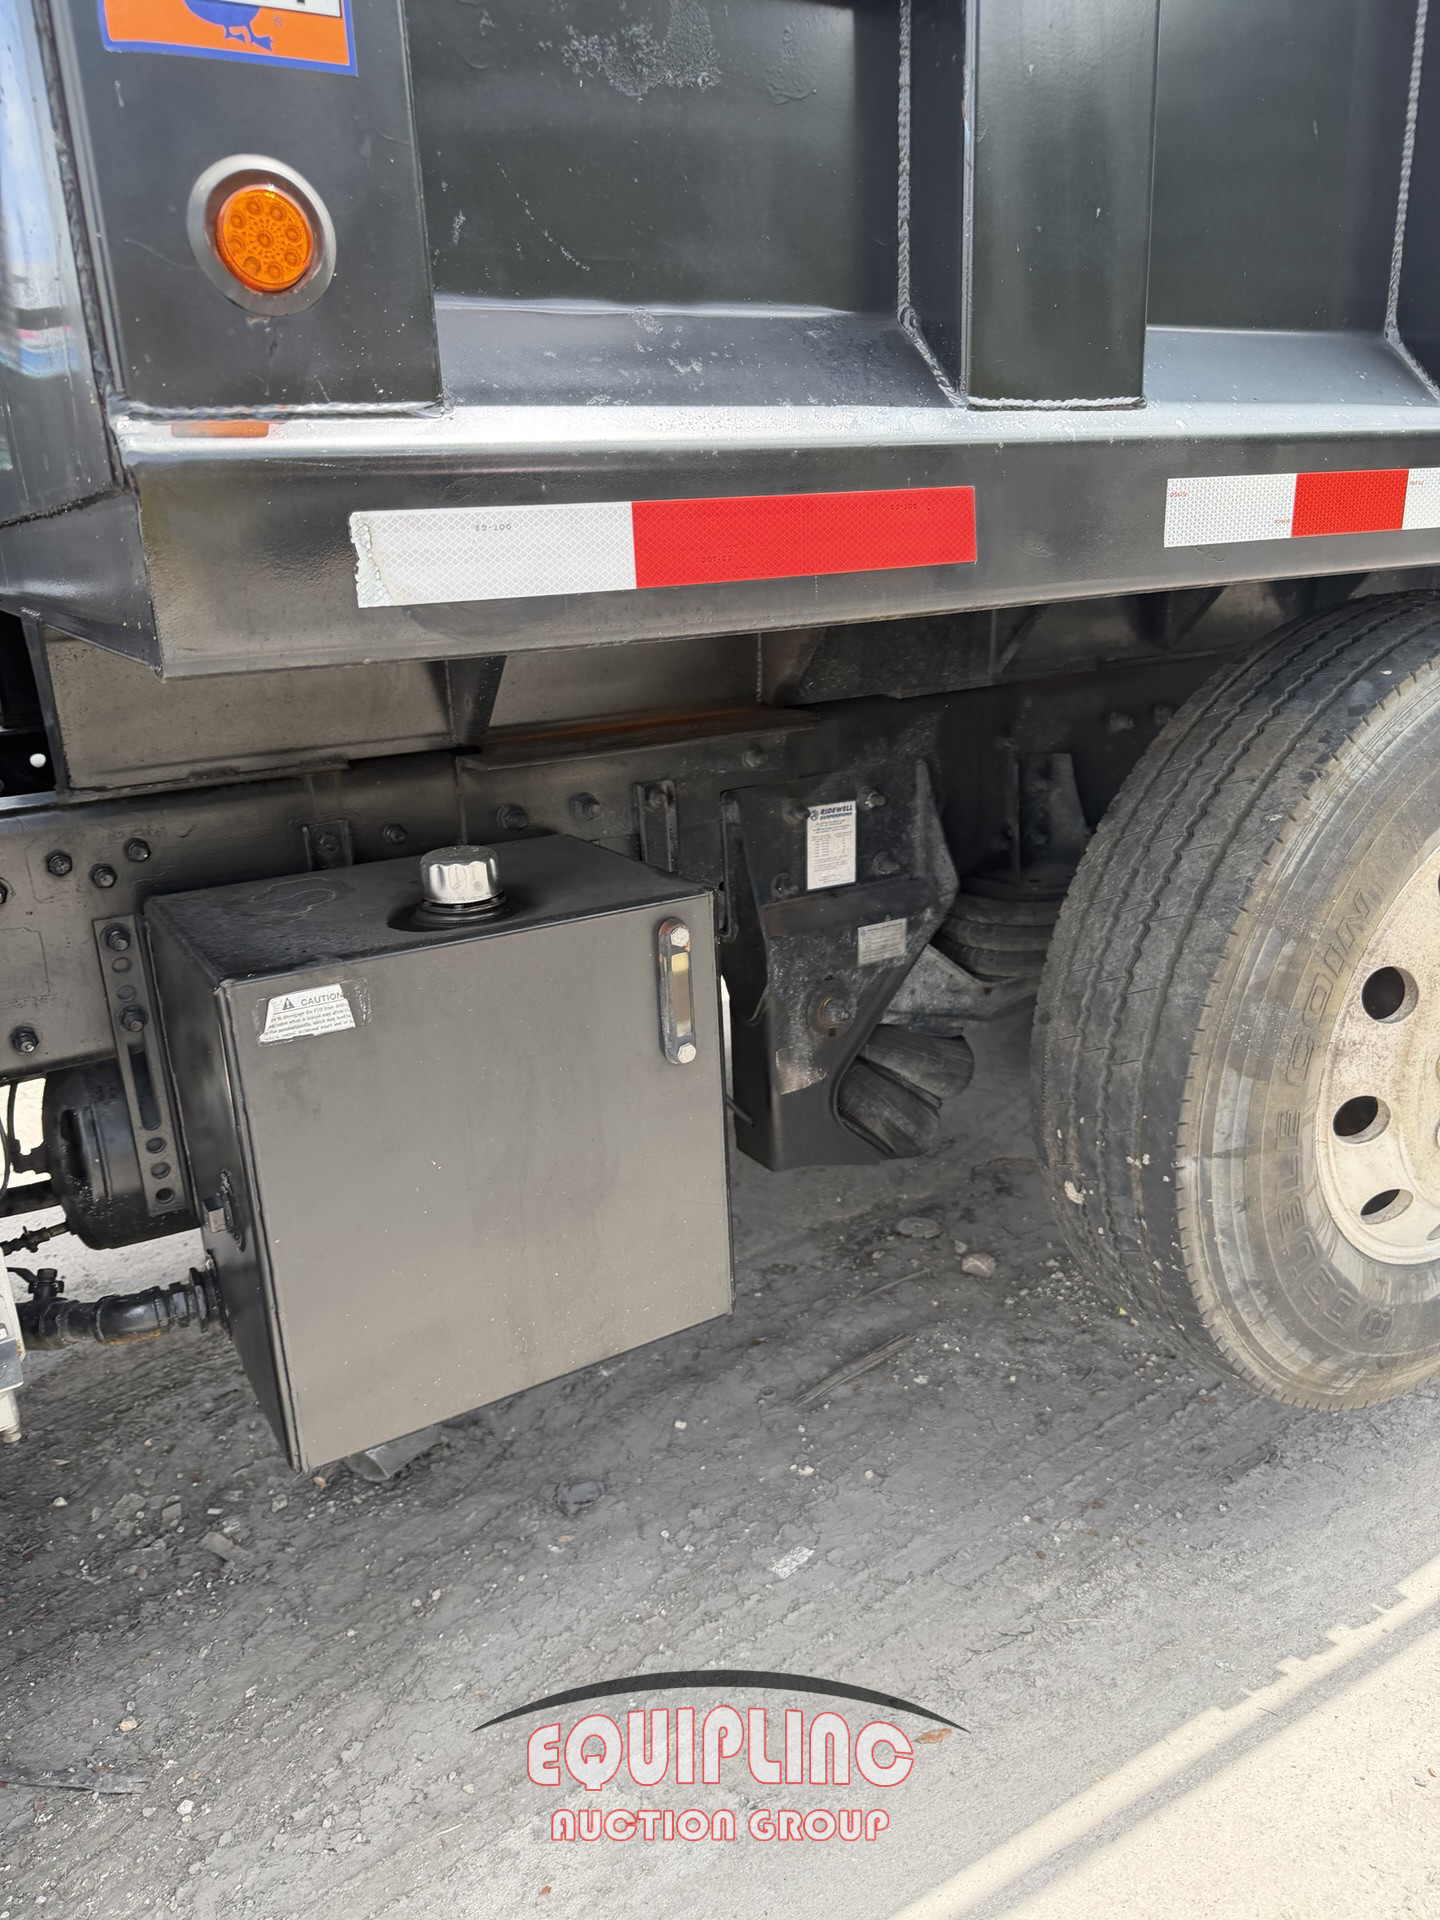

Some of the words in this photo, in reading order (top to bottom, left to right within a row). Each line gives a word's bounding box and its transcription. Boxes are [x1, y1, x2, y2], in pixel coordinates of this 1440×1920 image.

[475, 523, 512, 532] DOT-C2
[820, 805, 853, 815] RIDEWELL
[1286, 886, 1371, 1088] COIN
[300, 992, 344, 1006] CAUTION
